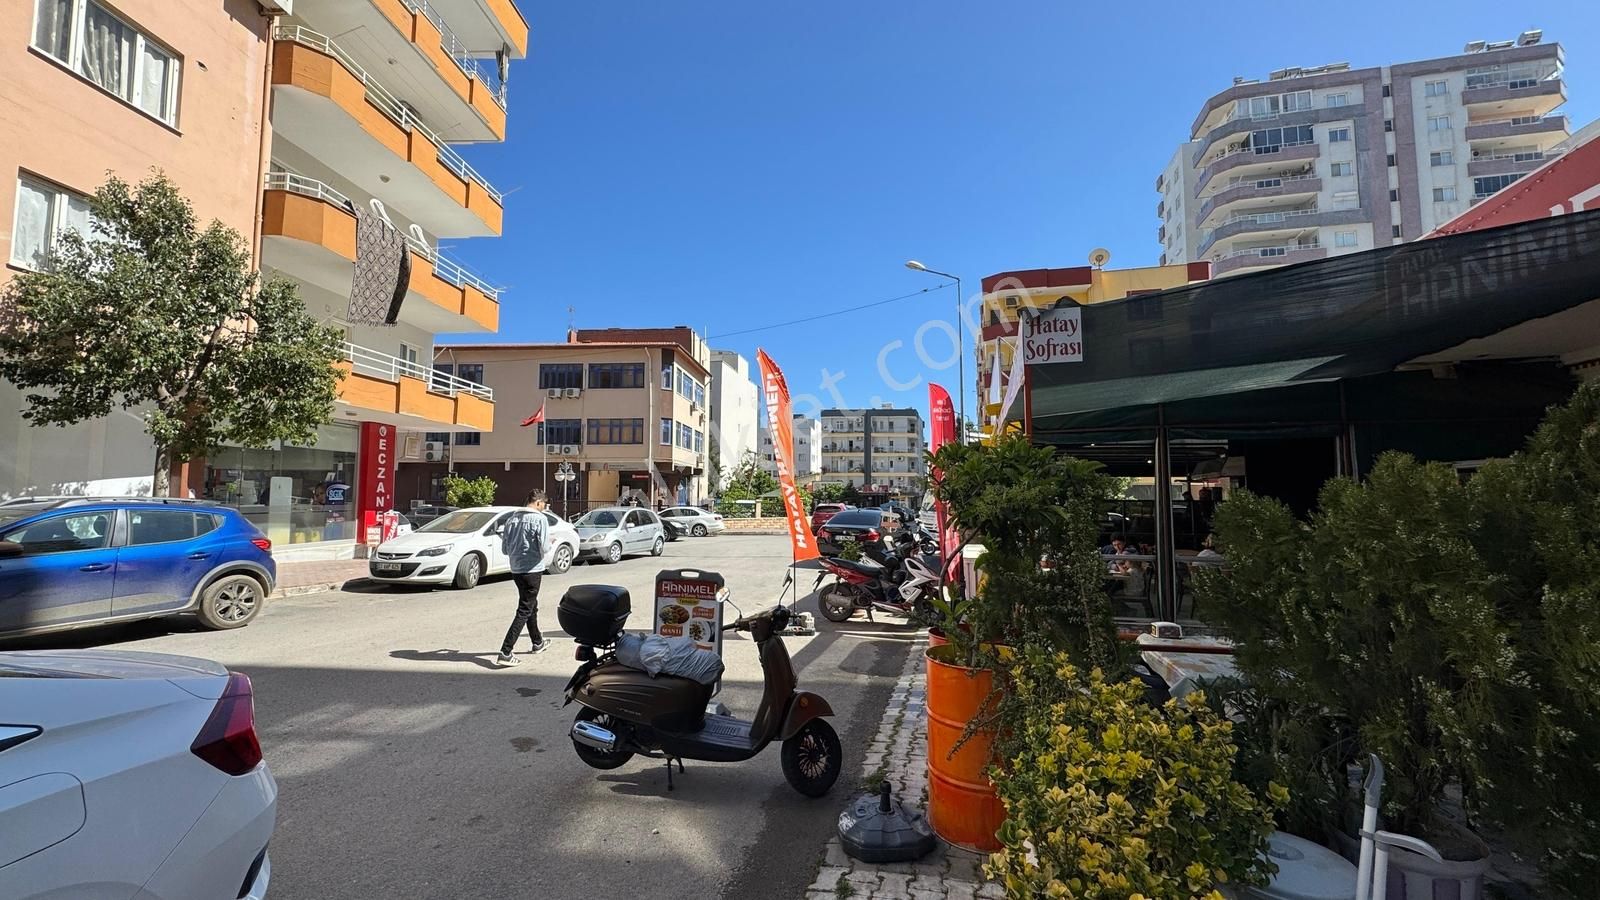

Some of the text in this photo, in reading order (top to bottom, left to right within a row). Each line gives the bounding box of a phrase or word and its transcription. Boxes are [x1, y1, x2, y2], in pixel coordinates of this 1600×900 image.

[1025, 315, 1078, 338] Hatay
[1025, 337, 1081, 361] Sofrası
[376, 439, 387, 522] ECZANE
[781, 481, 808, 549] HATAY
[662, 583, 717, 595] HANIMELİ
